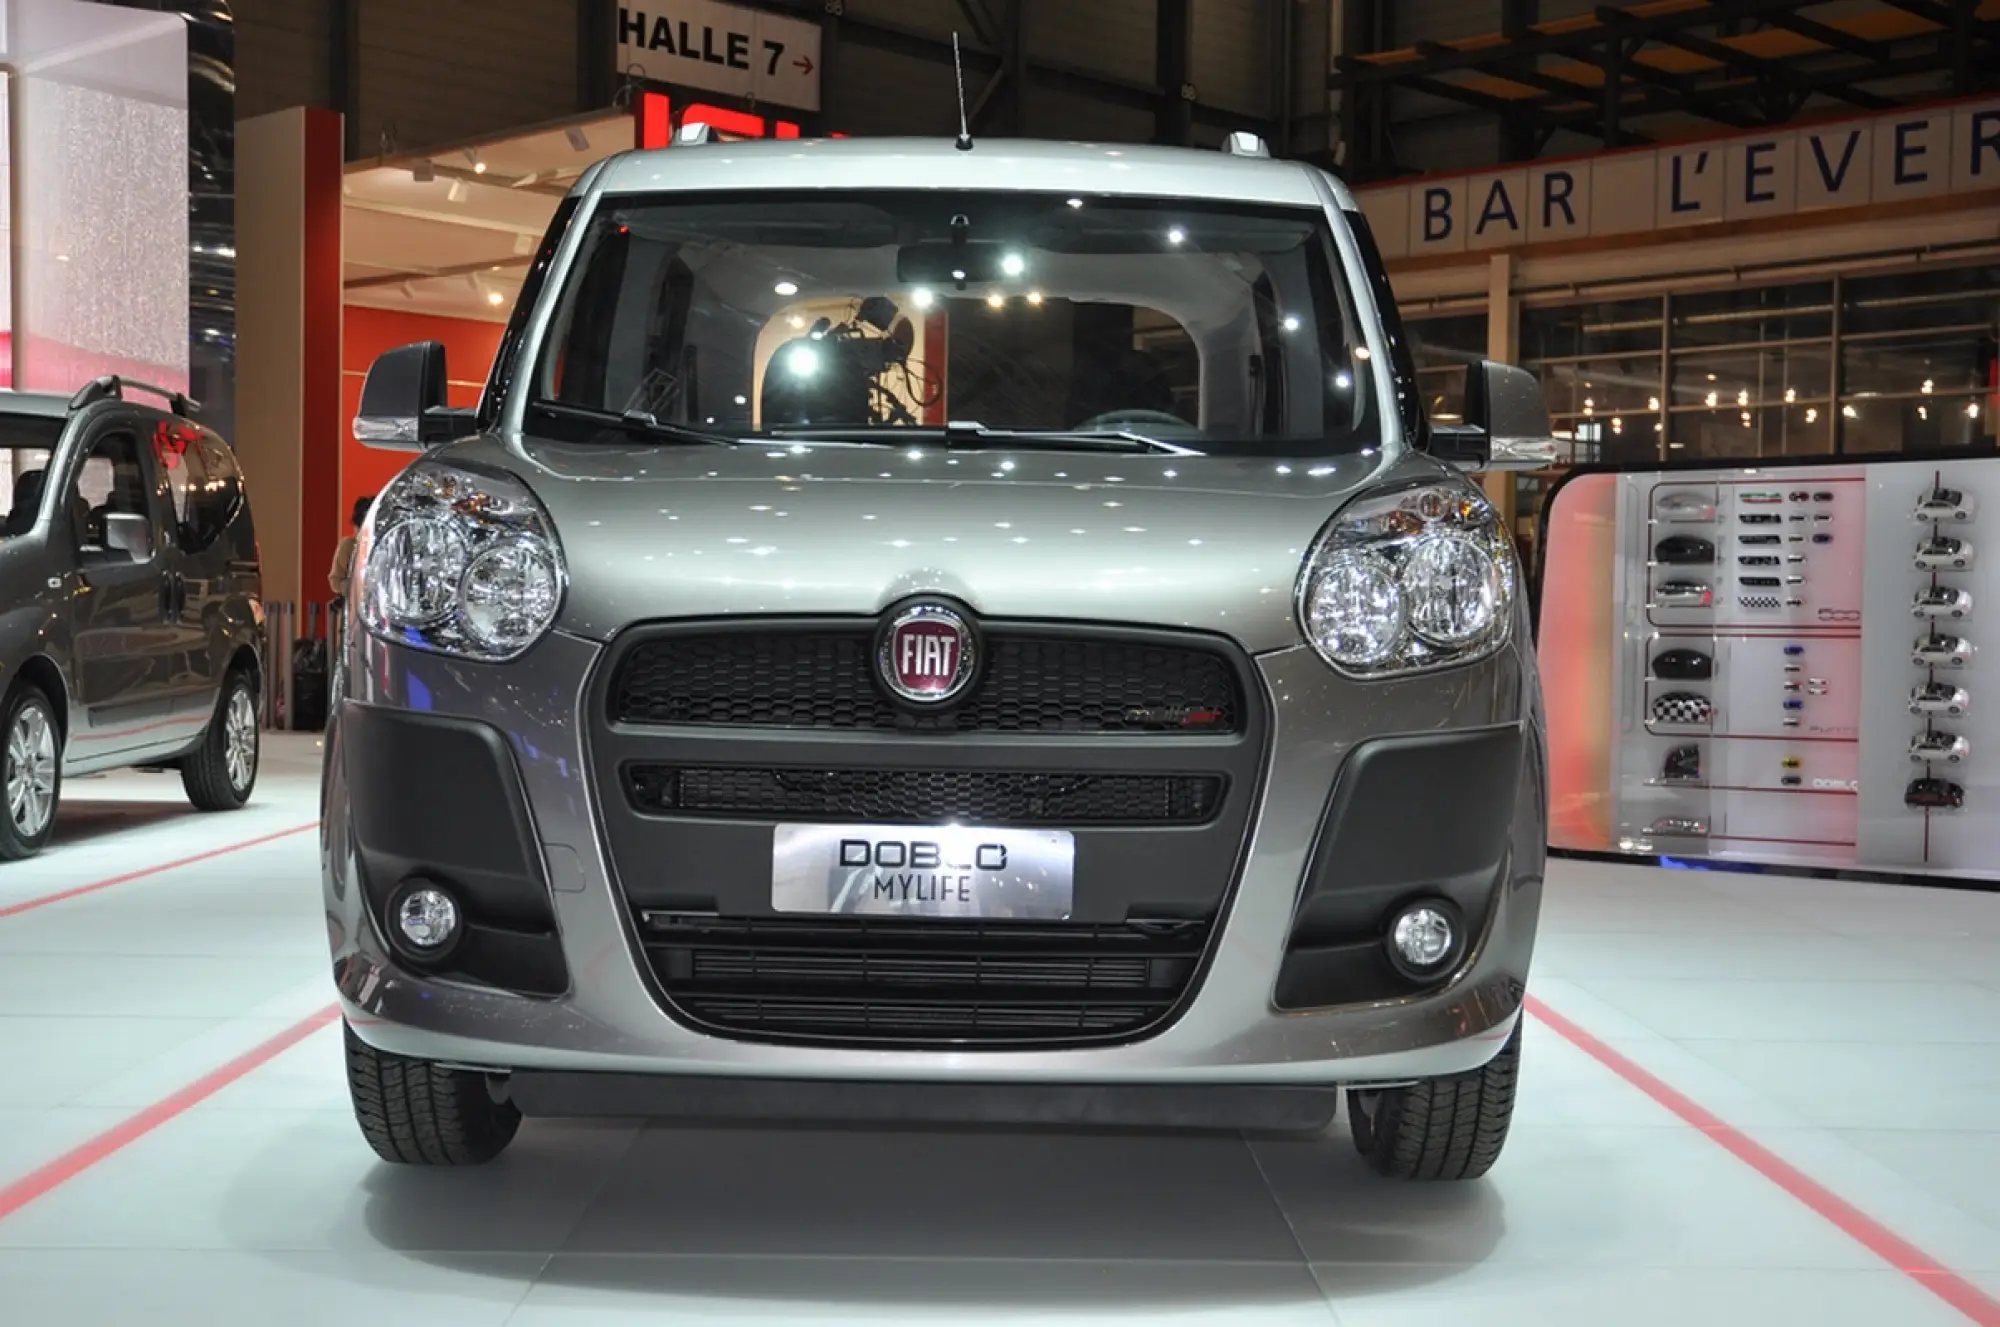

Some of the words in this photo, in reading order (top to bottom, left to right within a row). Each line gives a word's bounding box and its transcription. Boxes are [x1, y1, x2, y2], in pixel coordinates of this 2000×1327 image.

[618, 8, 749, 70] HALLE
[763, 40, 785, 76] 7
[1424, 171, 1576, 242] BAR
[1671, 109, 2000, 212] L'EVER
[902, 634, 956, 676] FIAT
[873, 873, 971, 901] MYLIFE
